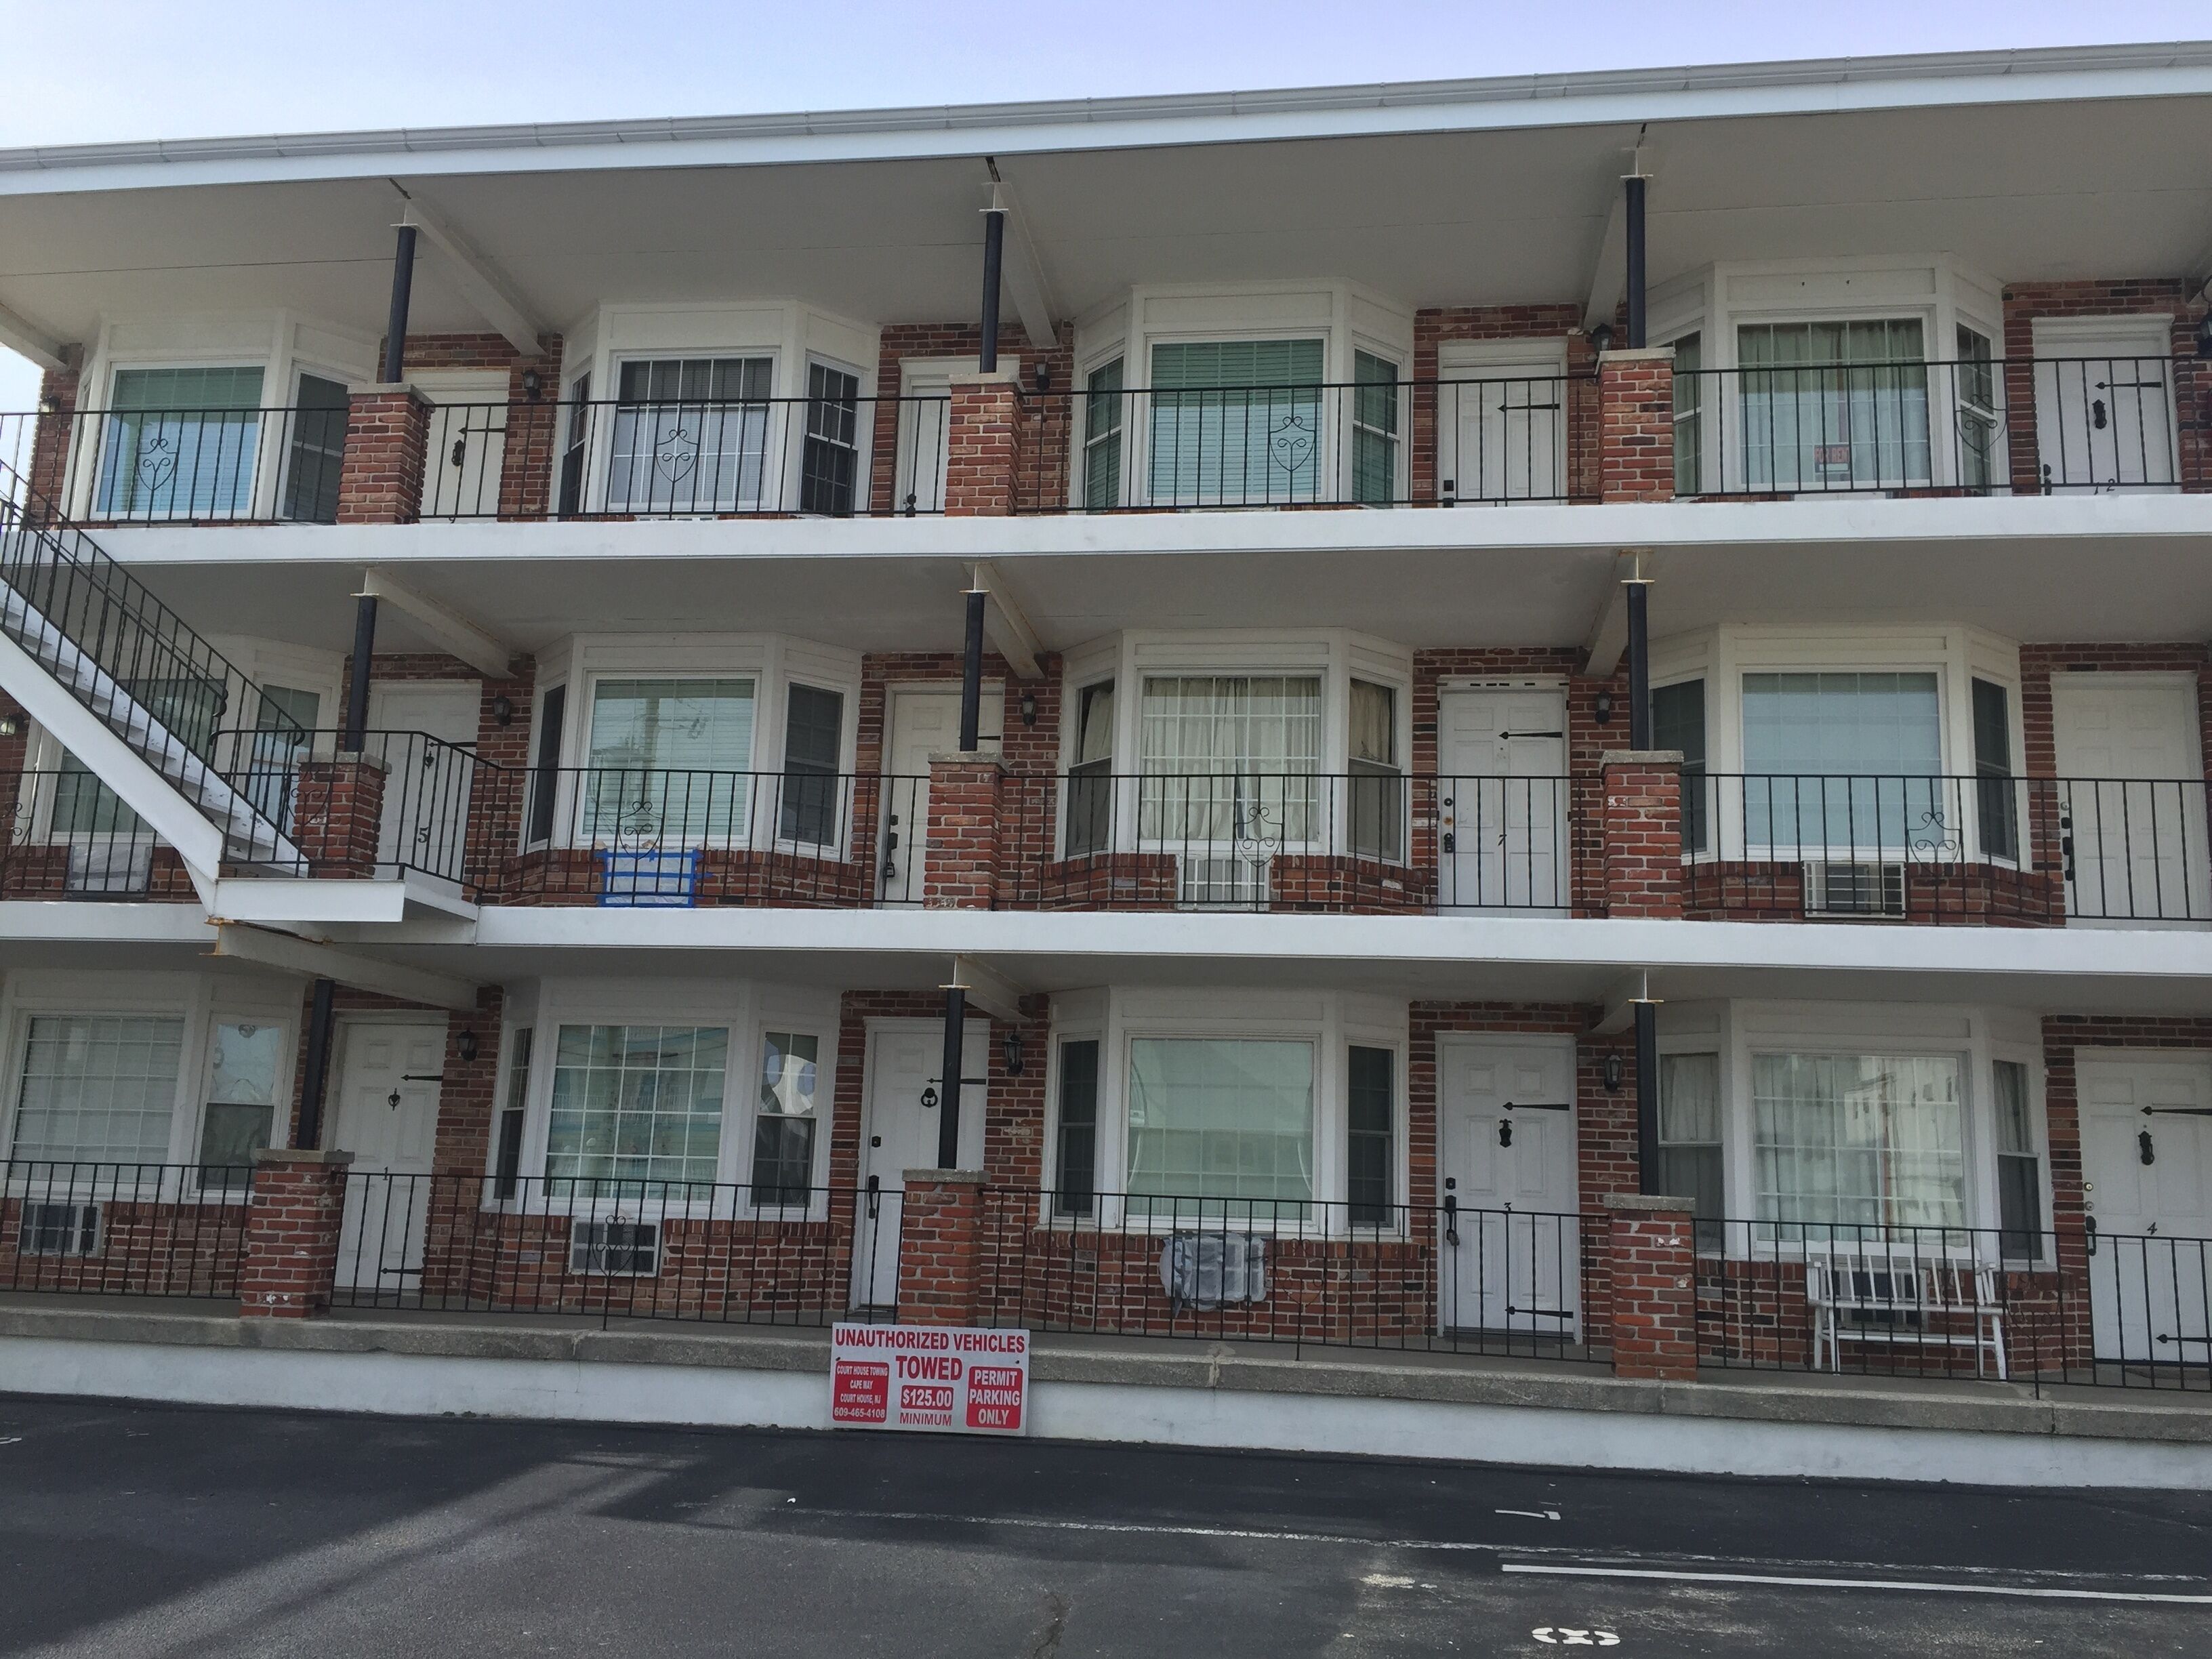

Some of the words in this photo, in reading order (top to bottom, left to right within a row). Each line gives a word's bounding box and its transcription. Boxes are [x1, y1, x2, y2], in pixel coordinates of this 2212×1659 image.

[2093, 478, 2116, 495] 12
[417, 827, 430, 843] 5
[1498, 834, 1507, 846] 7
[382, 1166, 388, 1181] 1
[1504, 1202, 1512, 1214] 3
[2147, 1221, 2158, 1235] 4
[836, 1328, 949, 1350] UNAUTHORIZED
[954, 1333, 1025, 1353] VEHICLES
[837, 1366, 853, 1375] COURT
[853, 1366, 869, 1376] HOUSE
[870, 1366, 888, 1376] TOWING
[895, 1355, 962, 1380] TOWED
[850, 1380, 862, 1389] CAPE
[863, 1380, 874, 1390] MAY
[974, 1370, 1018, 1387] PERMIT
[840, 1393, 856, 1403] COURT
[857, 1393, 874, 1405] HOUSE,
[874, 1394, 882, 1404] NJ
[902, 1388, 952, 1408] $125.00
[969, 1389, 1021, 1406] PARKING
[834, 1407, 885, 1418] 609-465-4108
[900, 1412, 952, 1427] MINIMUM
[978, 1408, 1010, 1425] ONLY
